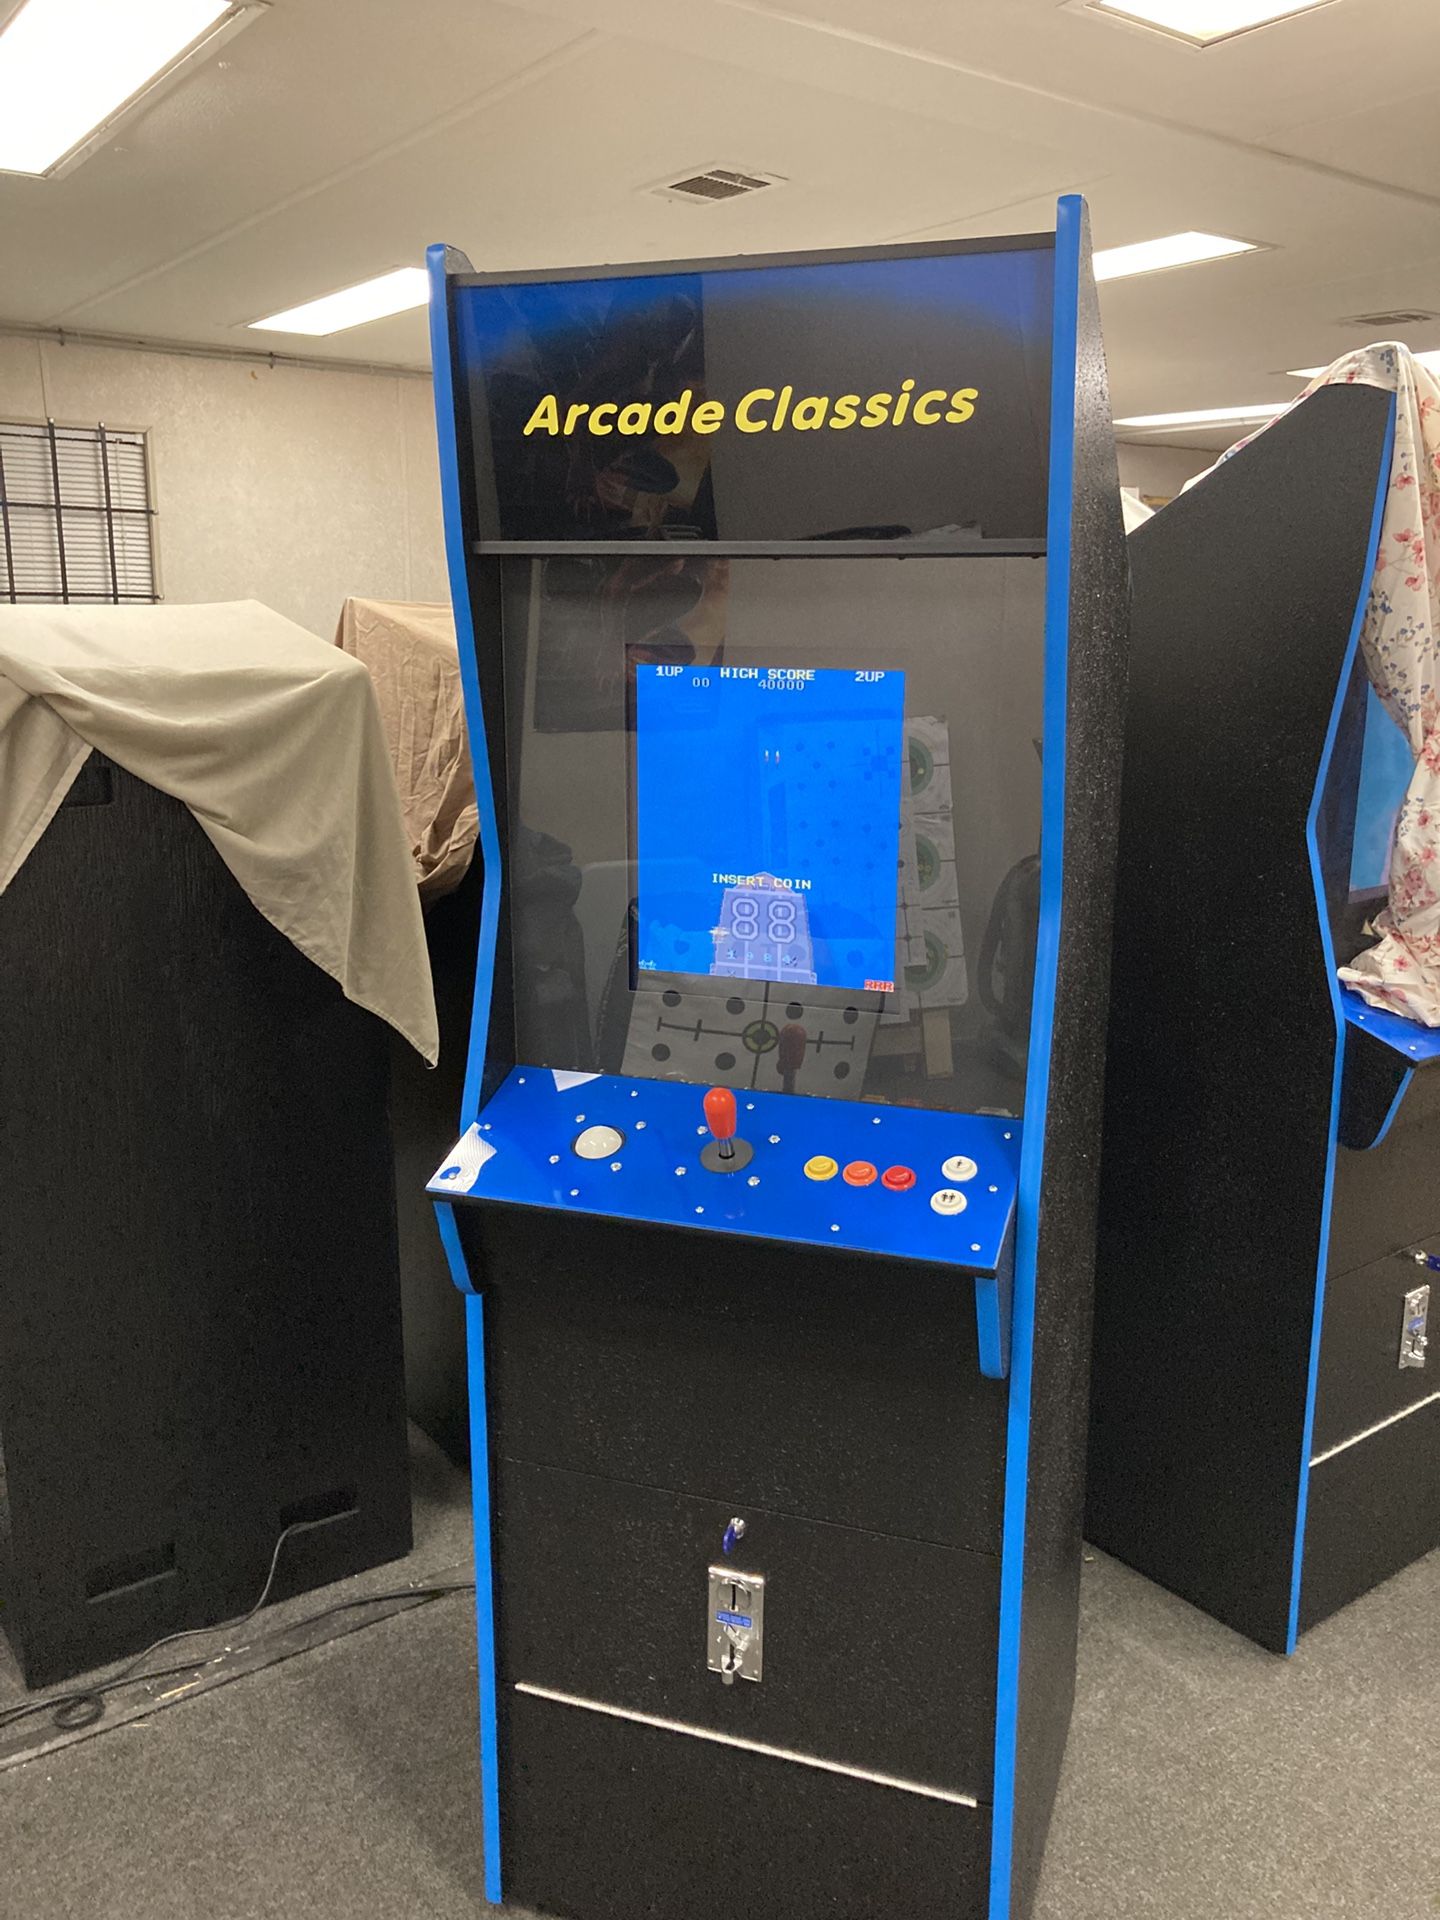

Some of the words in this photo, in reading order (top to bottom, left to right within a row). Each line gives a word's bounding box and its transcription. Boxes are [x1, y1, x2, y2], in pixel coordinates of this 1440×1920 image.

[523, 389, 725, 436] Arcade
[734, 378, 979, 433] Classics
[656, 665, 683, 677] 1UP
[720, 667, 759, 679] HIGH
[767, 668, 816, 681] SCORE
[855, 671, 885, 682] 2UP
[692, 677, 710, 688] 00
[758, 679, 805, 690] 40000
[712, 873, 764, 886] INSERT
[773, 878, 812, 889] COIN
